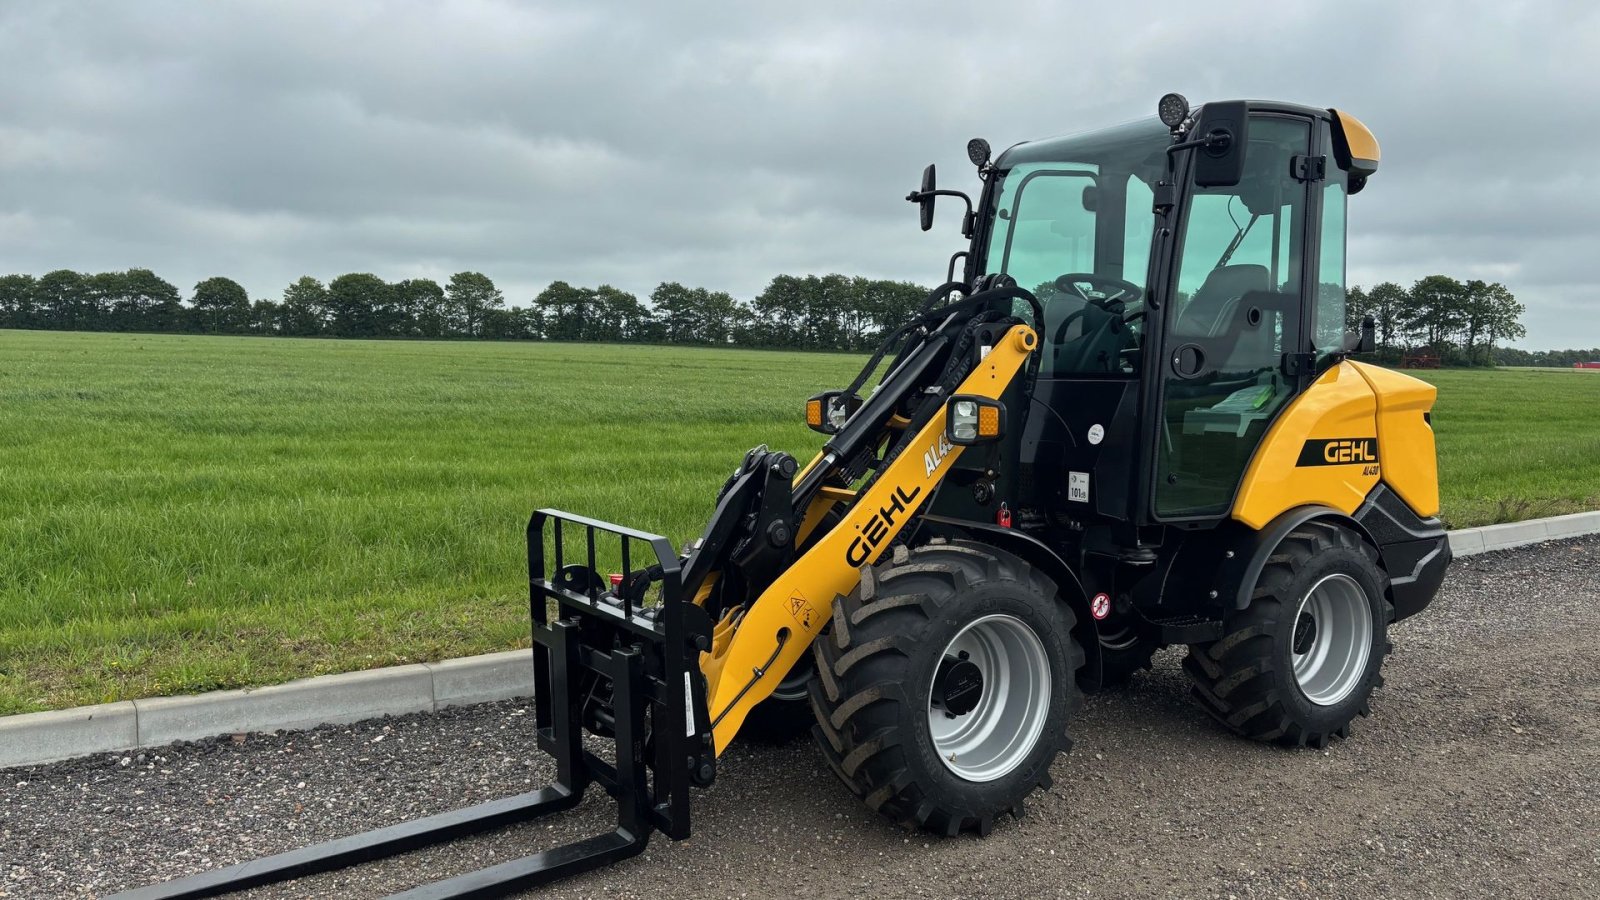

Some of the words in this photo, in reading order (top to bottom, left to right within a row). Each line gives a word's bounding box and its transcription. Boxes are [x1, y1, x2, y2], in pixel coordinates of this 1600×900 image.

[1324, 441, 1376, 463] GEHL
[1362, 465, 1379, 476] AL430
[846, 486, 921, 568] GEHL
